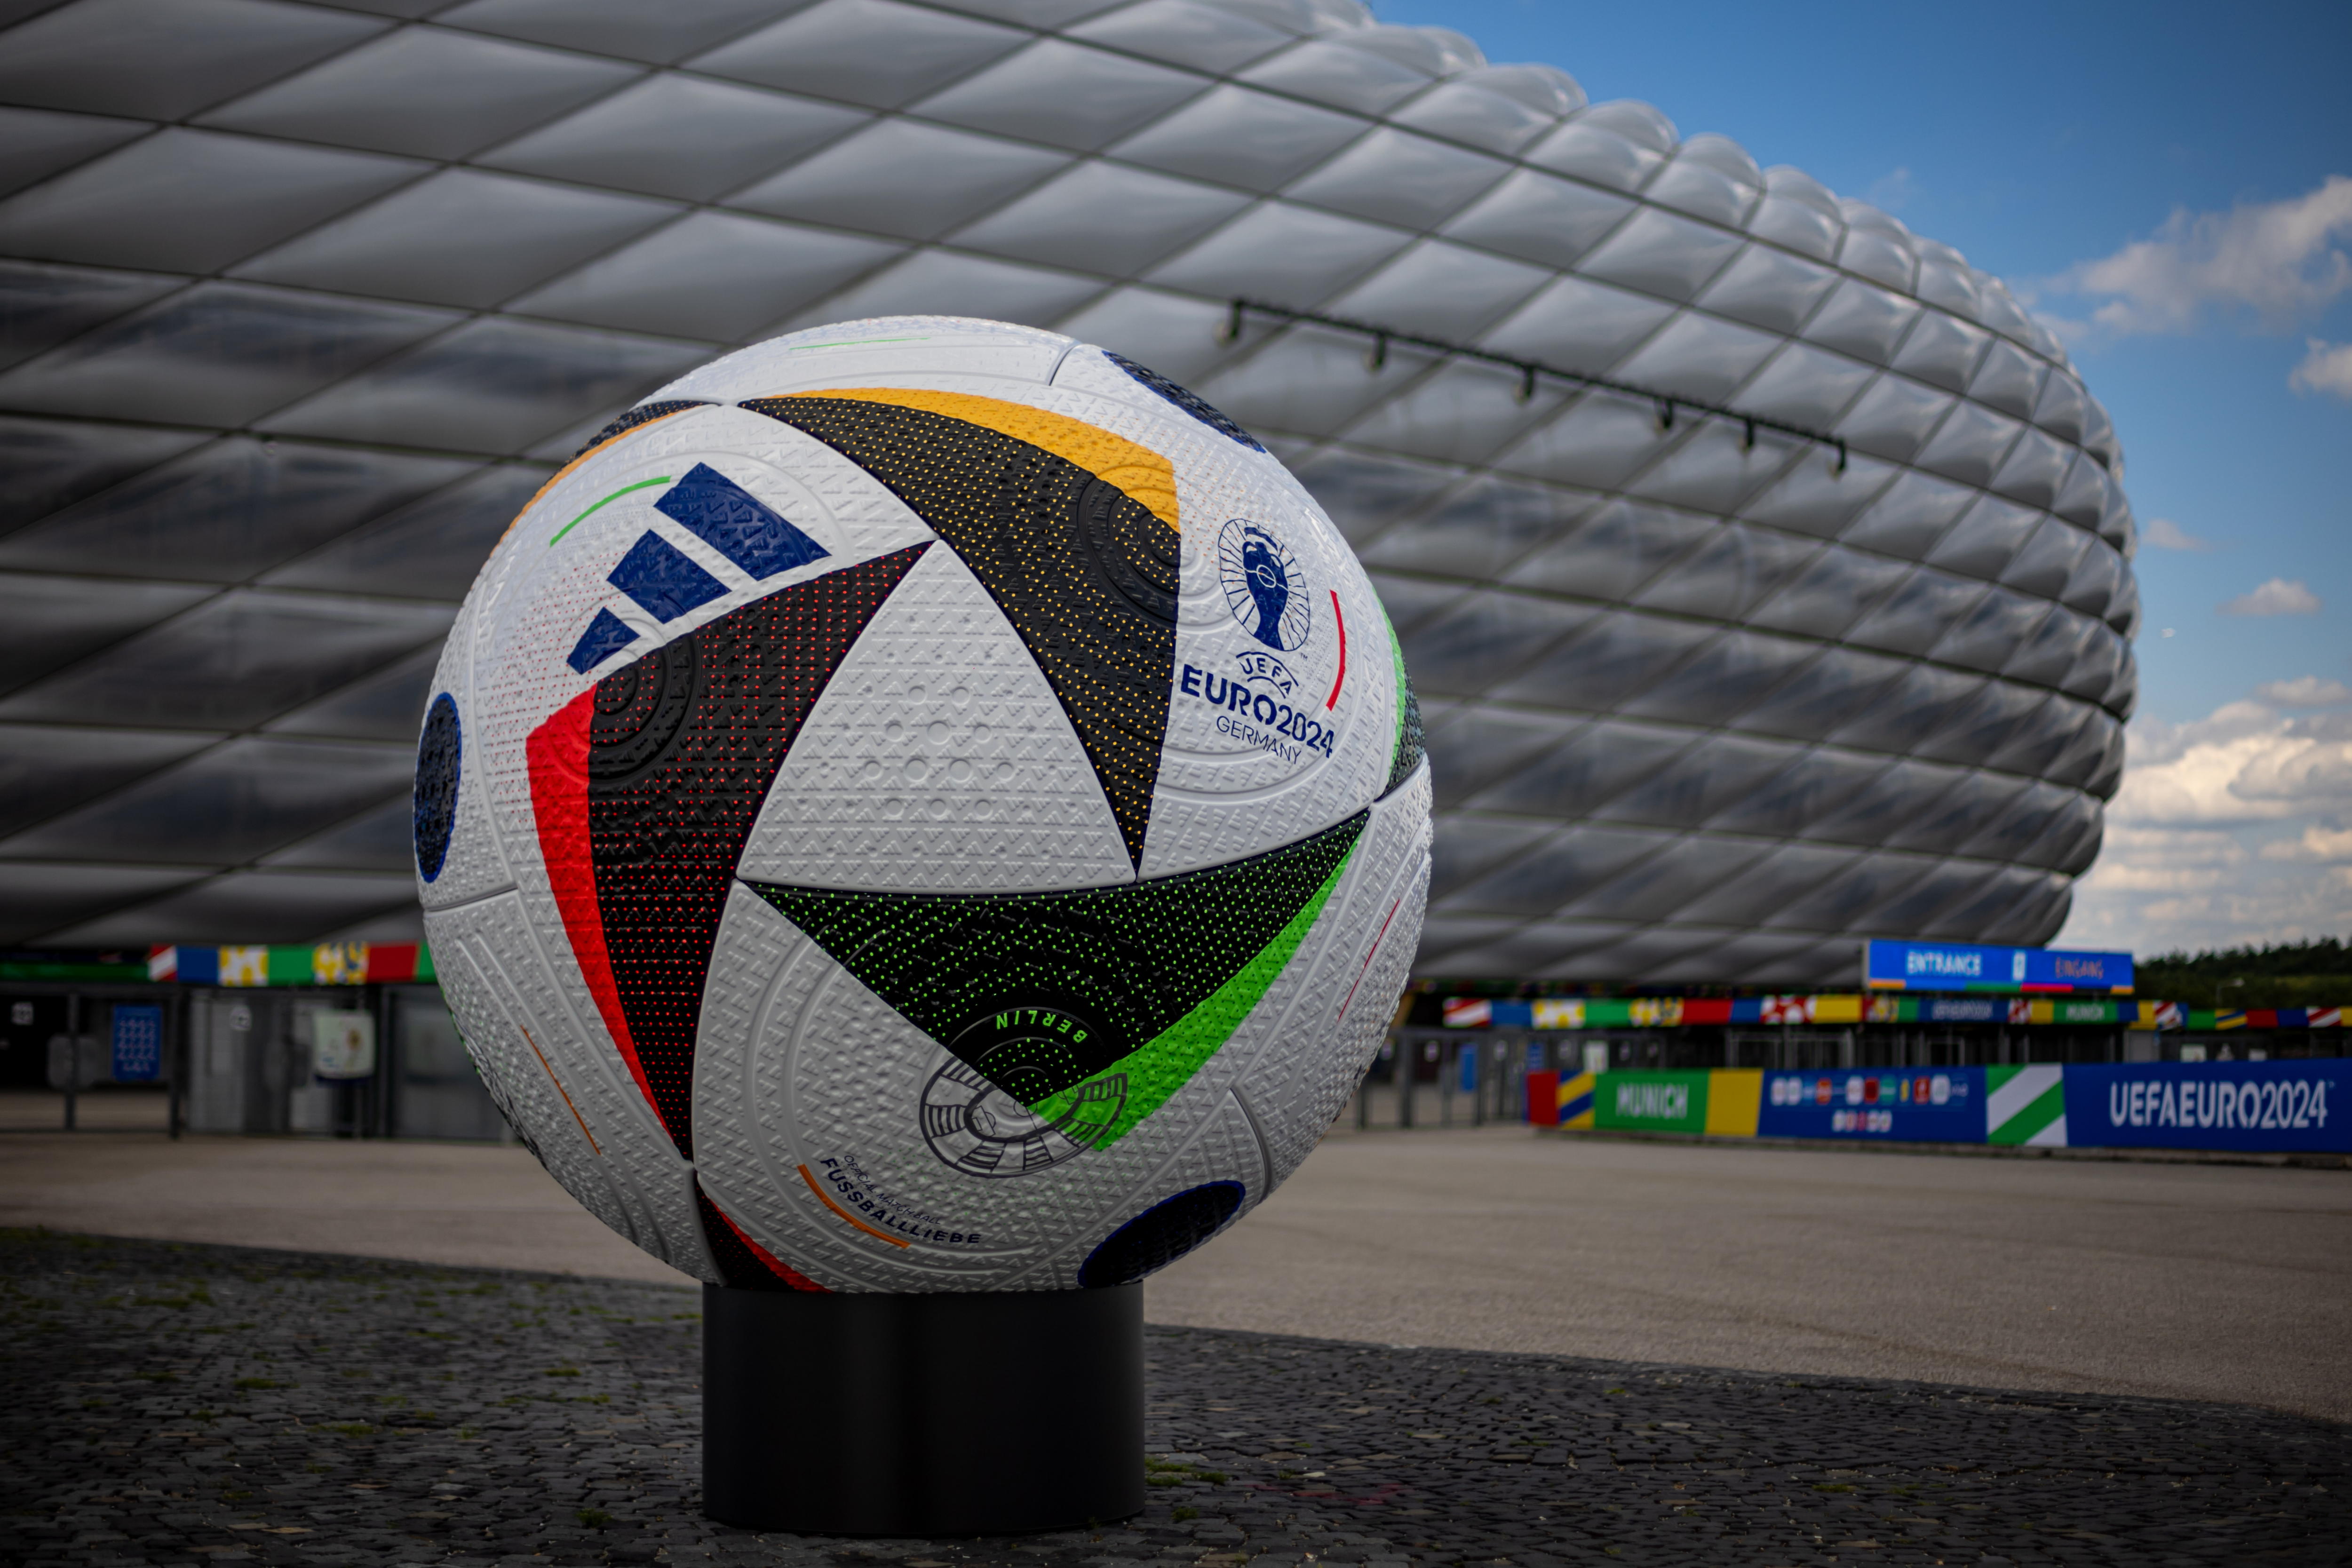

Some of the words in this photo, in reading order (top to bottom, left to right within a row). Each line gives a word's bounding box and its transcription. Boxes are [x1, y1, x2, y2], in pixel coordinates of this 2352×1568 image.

[1239, 657, 1292, 695] UEFA
[1180, 663, 1335, 758] EURO2024
[1216, 716, 1302, 764] GERMANY
[1907, 950, 1981, 976] ENTRANCE
[995, 1010, 1088, 1043] BERLIN
[1616, 1082, 1688, 1119] MUNICH
[820, 1158, 982, 1243] FUSSBALLLIEBE
[844, 1155, 877, 1193] OFFICIAL
[876, 1193, 915, 1216] MATCH
[913, 1211, 941, 1225] BALL
